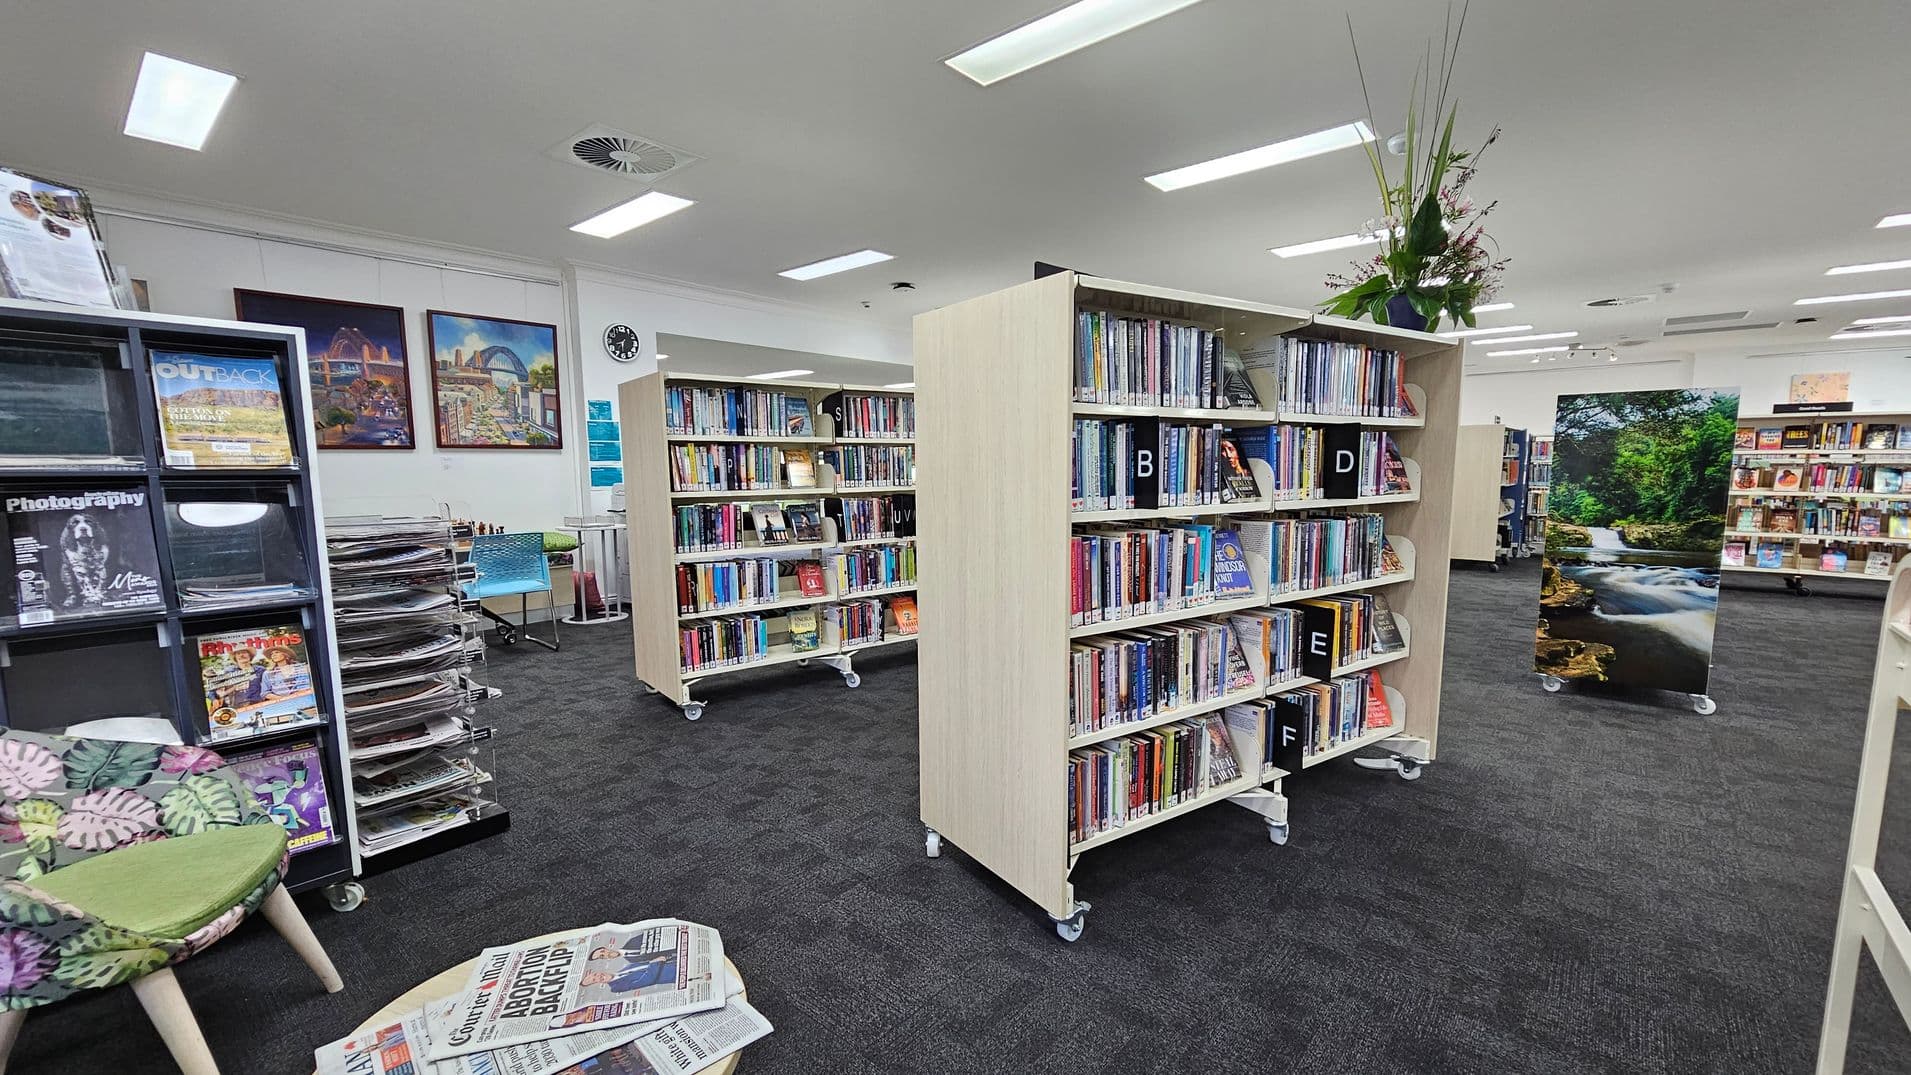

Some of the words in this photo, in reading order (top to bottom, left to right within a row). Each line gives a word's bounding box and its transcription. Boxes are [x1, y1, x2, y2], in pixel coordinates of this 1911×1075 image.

[156, 362, 274, 386] OUTBACK
[169, 412, 189, 421] THE
[190, 413, 226, 422] MOVE
[217, 409, 233, 417] ON
[737, 404, 744, 418] N
[835, 406, 842, 422] S
[727, 457, 734, 473] P
[1137, 450, 1154, 477] B
[1336, 450, 1355, 473] D
[6, 491, 146, 511] Photography
[836, 512, 843, 527] T
[894, 510, 901, 523] U
[905, 510, 911, 523] V
[201, 633, 304, 657] Rhthms
[1310, 631, 1328, 656] E
[1282, 725, 1297, 747] F
[287, 831, 328, 849] CAFFEINE
[500, 945, 551, 1019] ABORTION
[530, 948, 574, 1017] BACKFLIP
[448, 991, 492, 1047] Courier
[480, 952, 511, 983] Mail
[655, 1029, 676, 1045] gift
[676, 1028, 707, 1060] mansion
[668, 1042, 692, 1070] White
